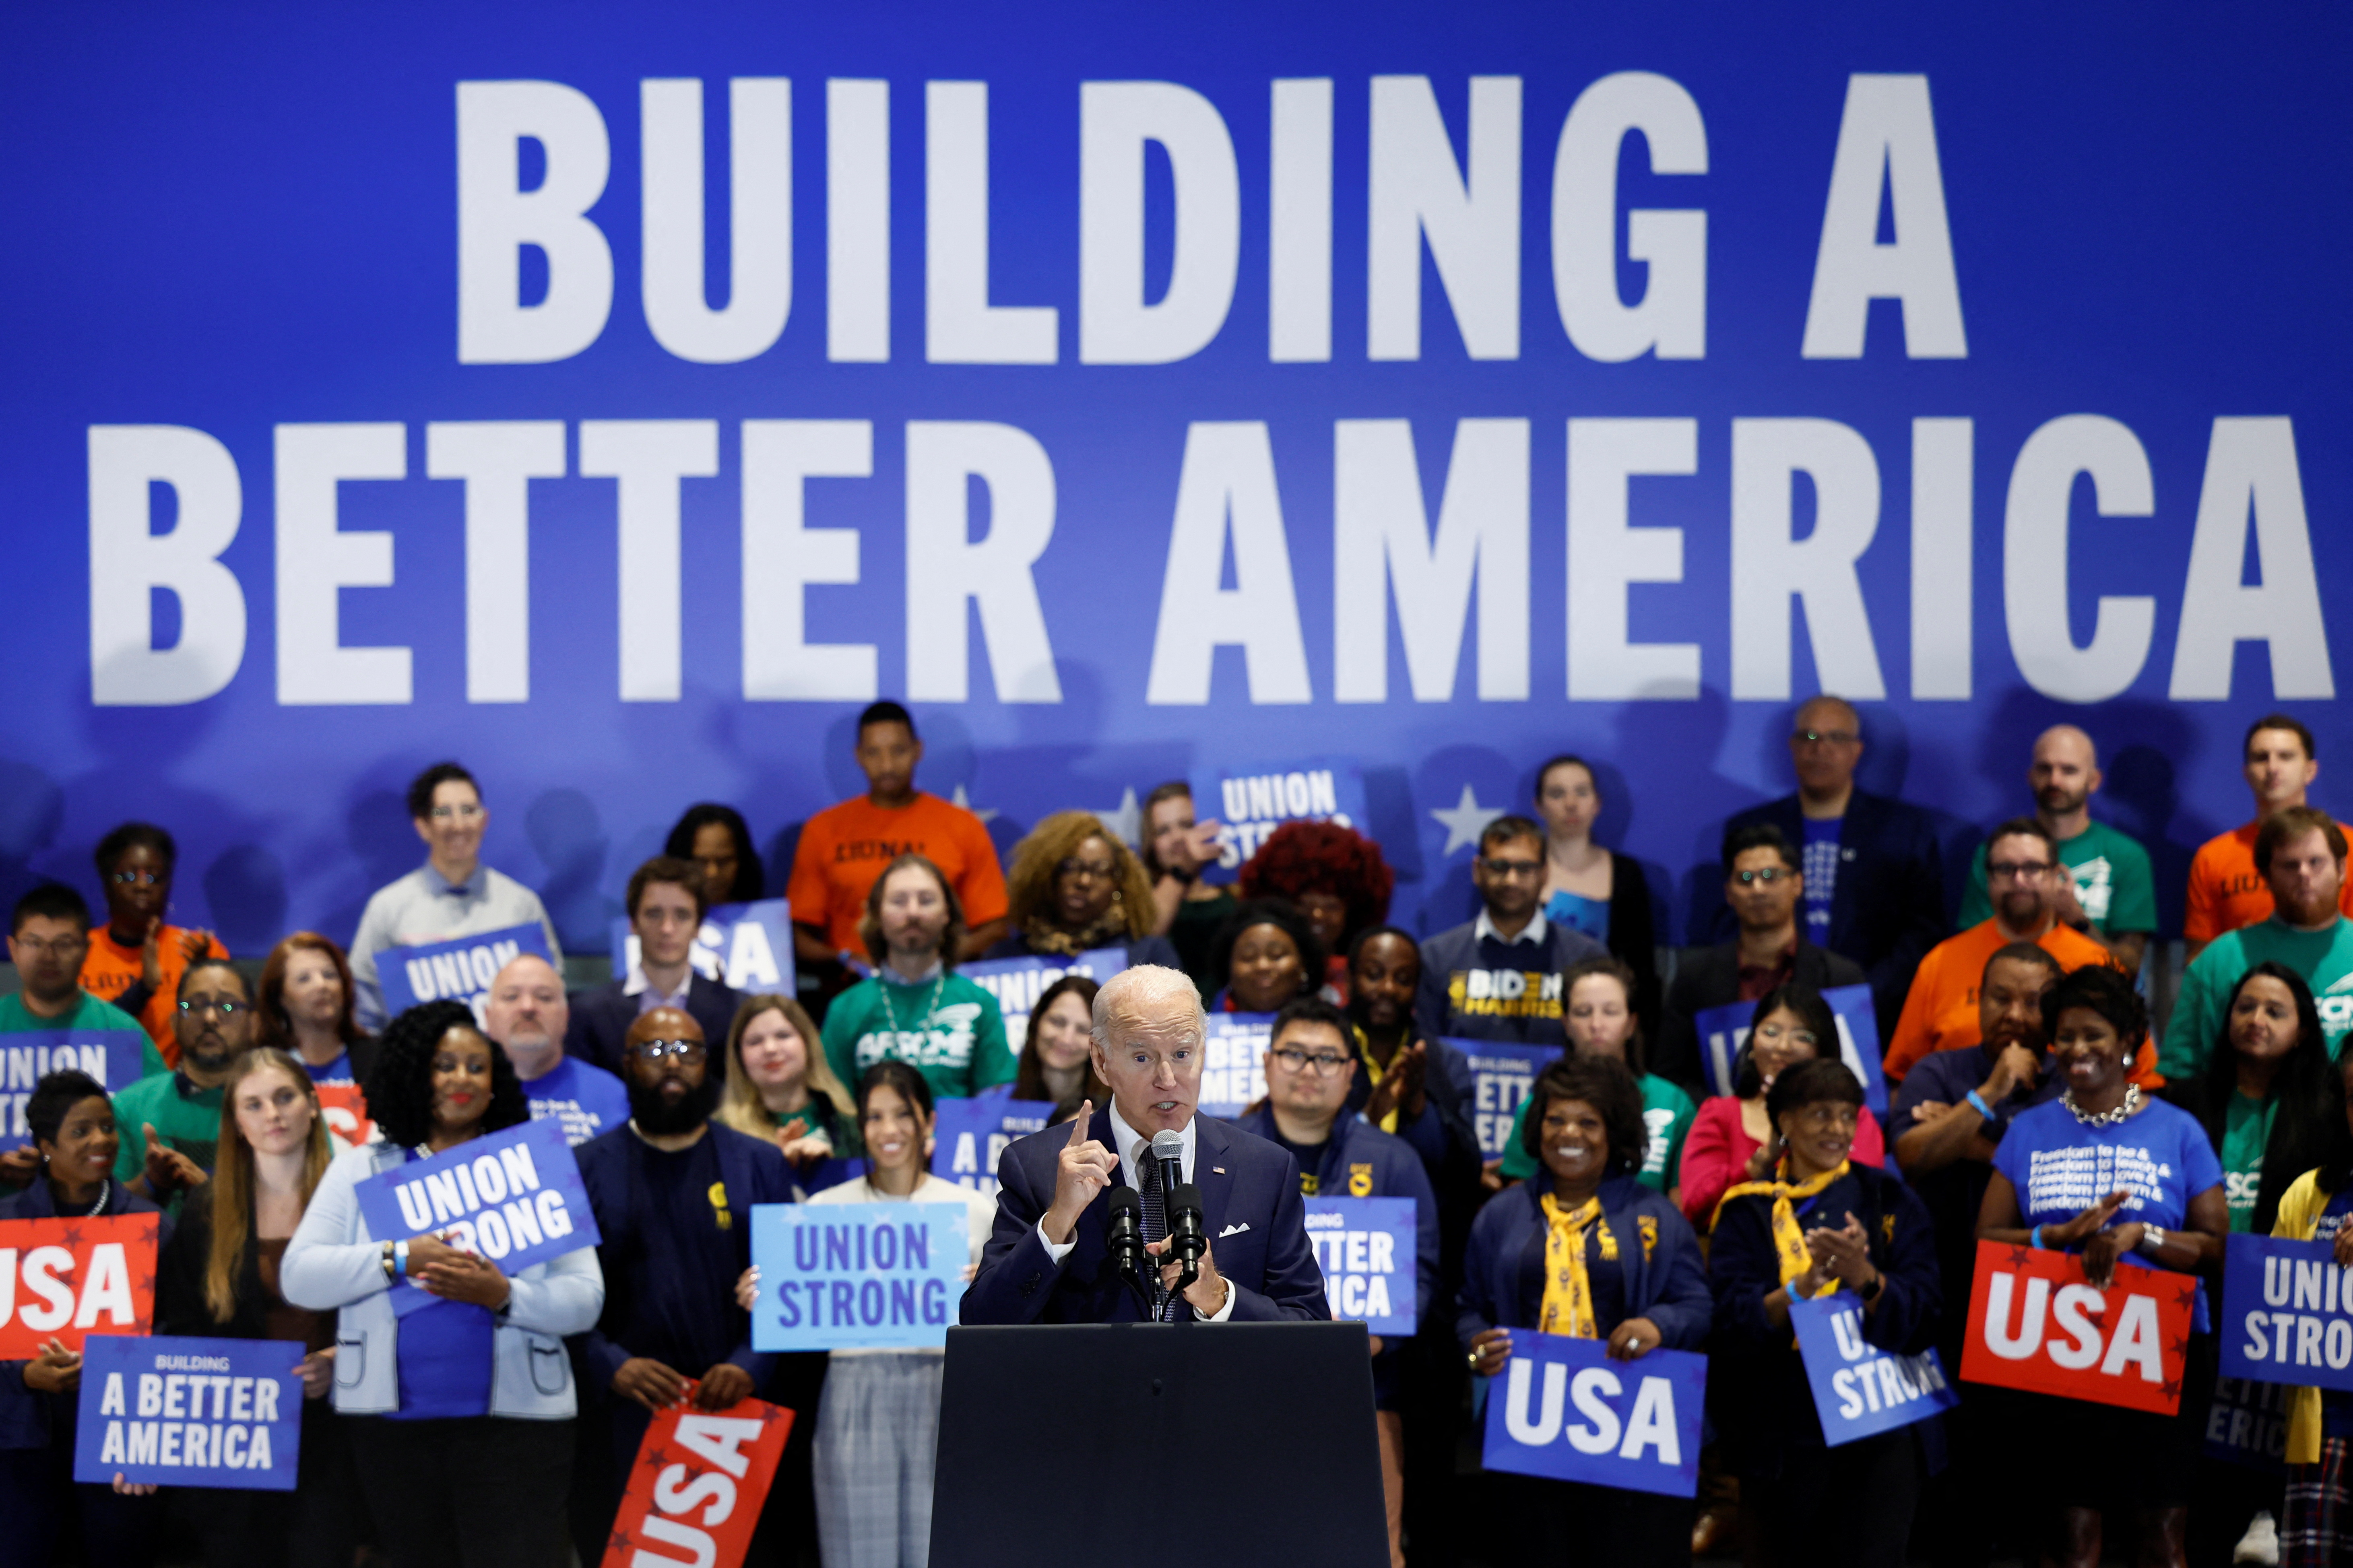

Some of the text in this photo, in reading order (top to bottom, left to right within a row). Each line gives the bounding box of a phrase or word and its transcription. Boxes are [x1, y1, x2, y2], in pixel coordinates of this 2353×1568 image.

[456, 72, 1967, 365] BUILDING A
[87, 415, 2335, 706] BETTER AMERICA
[1221, 769, 1337, 823] UNION
[1467, 968, 1563, 1001] BIDEN
[0, 1044, 107, 1091] NION
[1207, 1035, 1271, 1069] BET
[1475, 1072, 1534, 1113] ETT
[952, 1131, 978, 1174] A
[2030, 1157, 2095, 1176] Freedom
[2097, 1157, 2113, 1171] to
[2158, 1162, 2171, 1178] &
[2031, 1143, 2150, 1164] Freedom to be &
[394, 1142, 541, 1232] UNION
[2028, 1168, 2095, 1188] Freedom
[2096, 1170, 2113, 1184] to
[2146, 1171, 2158, 1186] &
[2029, 1179, 2094, 1200] Freedom
[2095, 1182, 2112, 1197] to
[2151, 1185, 2164, 1203] &
[446, 1188, 574, 1261] RONG
[1303, 1213, 1345, 1230] DING
[2029, 1193, 2093, 1216] Freedom
[793, 1222, 929, 1272] UNION
[1307, 1230, 1395, 1274] TTER
[777, 1278, 947, 1329] STRONG
[2263, 1255, 2353, 1316] UNI
[1984, 1271, 2164, 1384] USA
[2243, 1310, 2353, 1370] STRO
[155, 1353, 231, 1373] BUILDING
[99, 1371, 281, 1423] A BETTER
[1505, 1356, 1682, 1467] USA
[99, 1419, 274, 1470] AMERICA
[630, 1413, 764, 1568] USA
